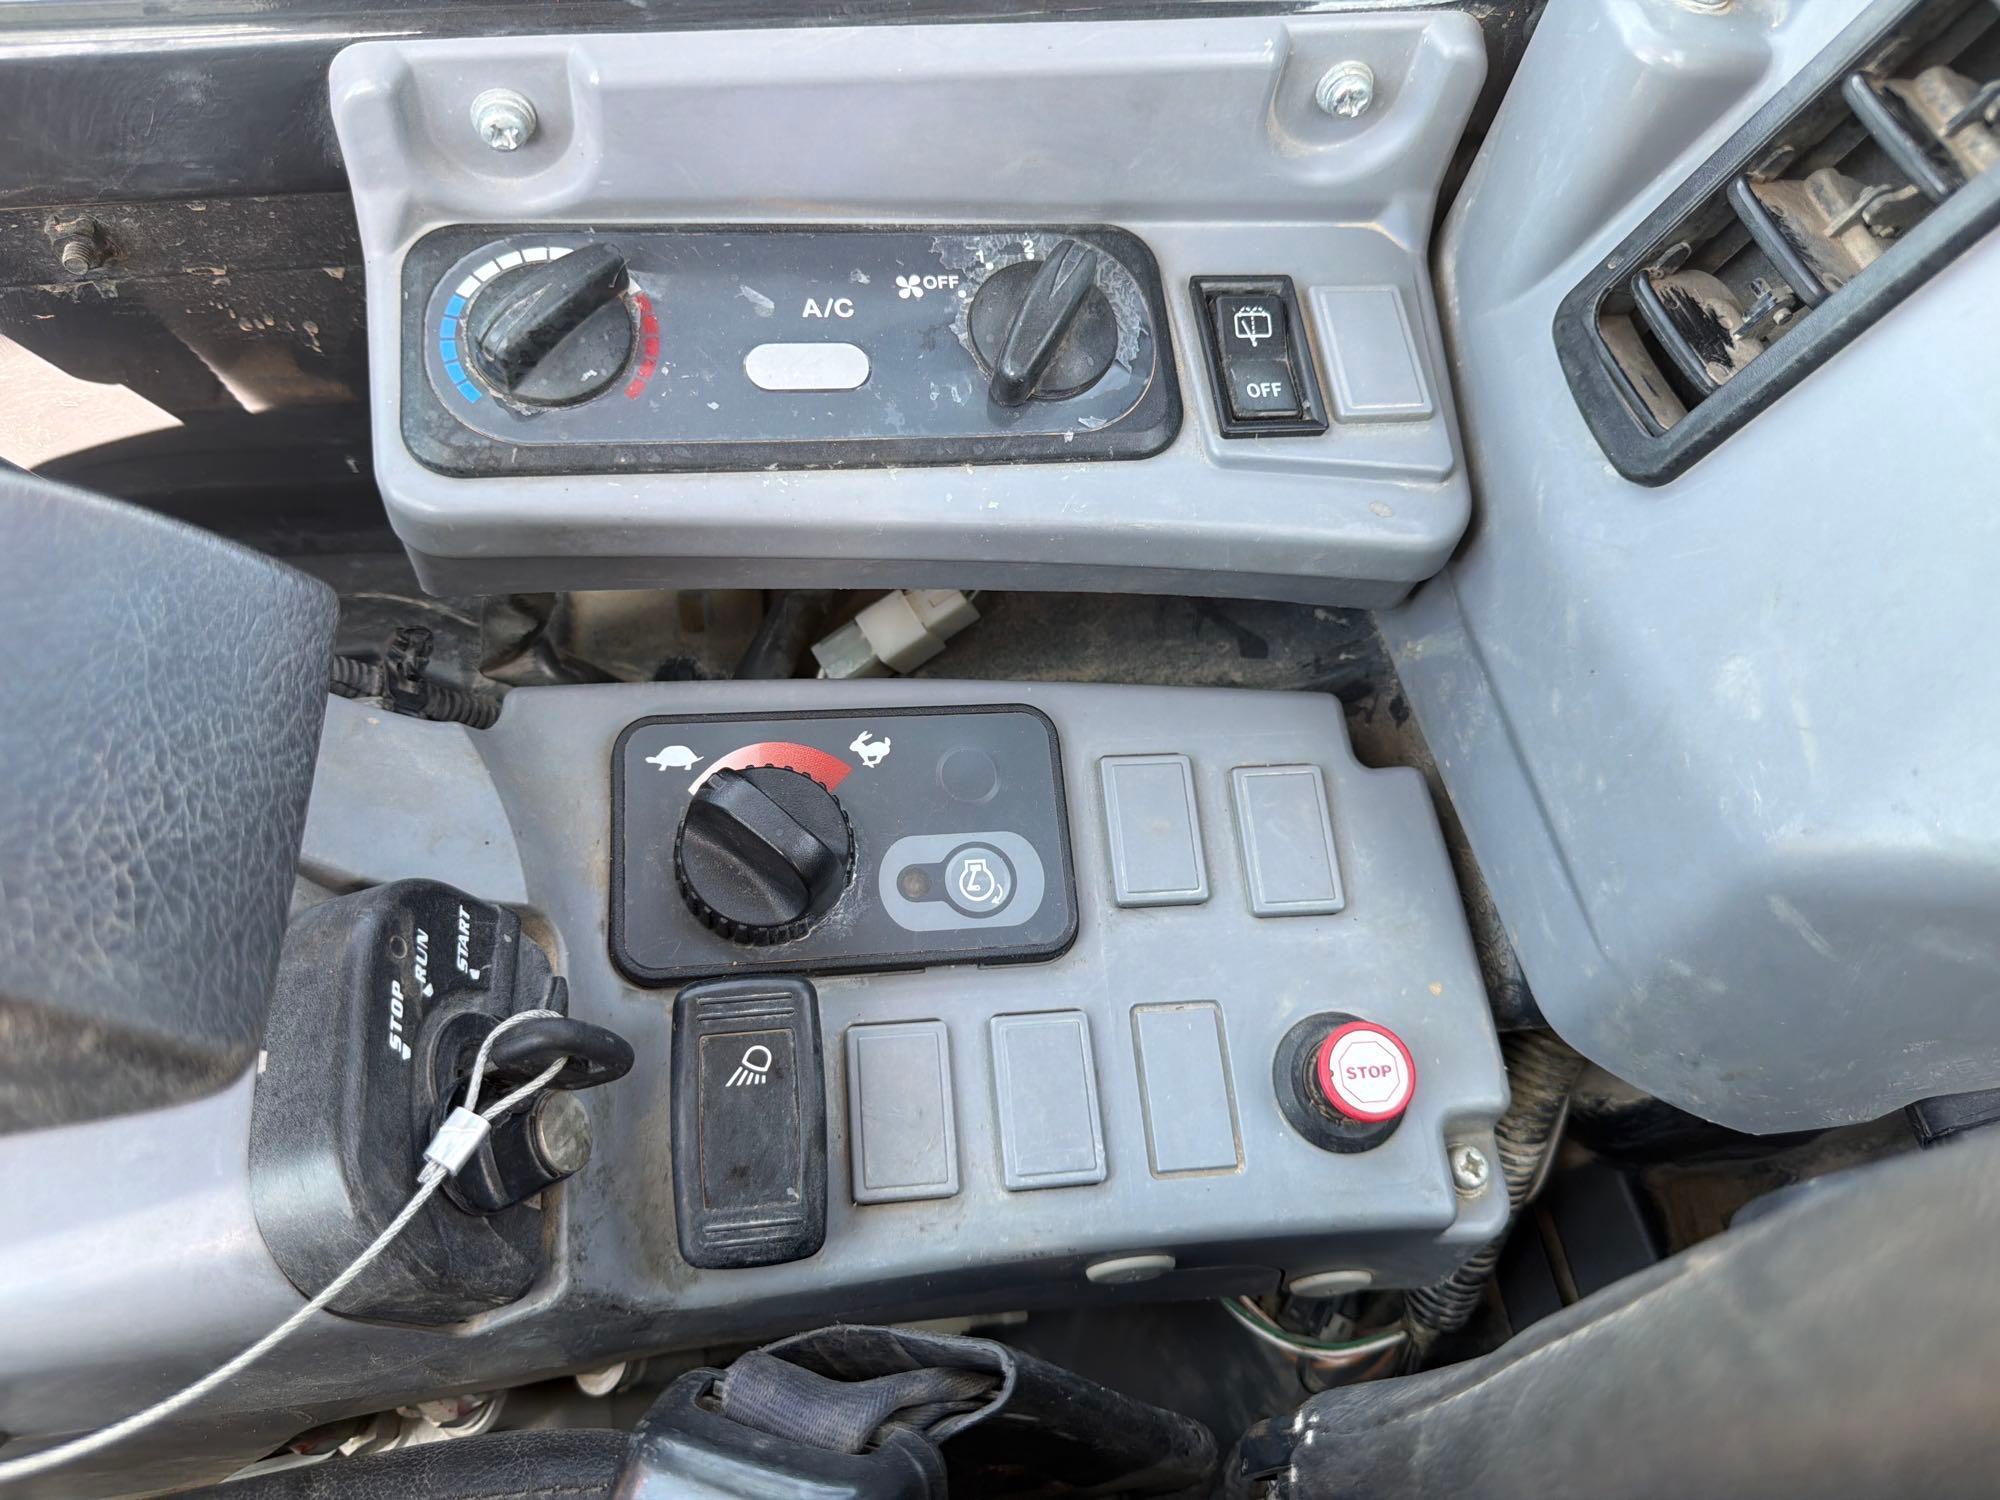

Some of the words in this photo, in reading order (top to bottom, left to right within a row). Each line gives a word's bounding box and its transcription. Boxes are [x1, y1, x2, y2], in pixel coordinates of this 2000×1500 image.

[1023, 239, 1035, 252] 2
[975, 249, 985, 263] 1
[922, 274, 960, 290] OFF
[802, 298, 855, 319] A/C
[1246, 382, 1282, 398] OFF
[456, 904, 471, 974] START
[414, 927, 430, 984] RUN
[389, 979, 405, 1053] STOP
[1345, 1064, 1392, 1080] STOP
